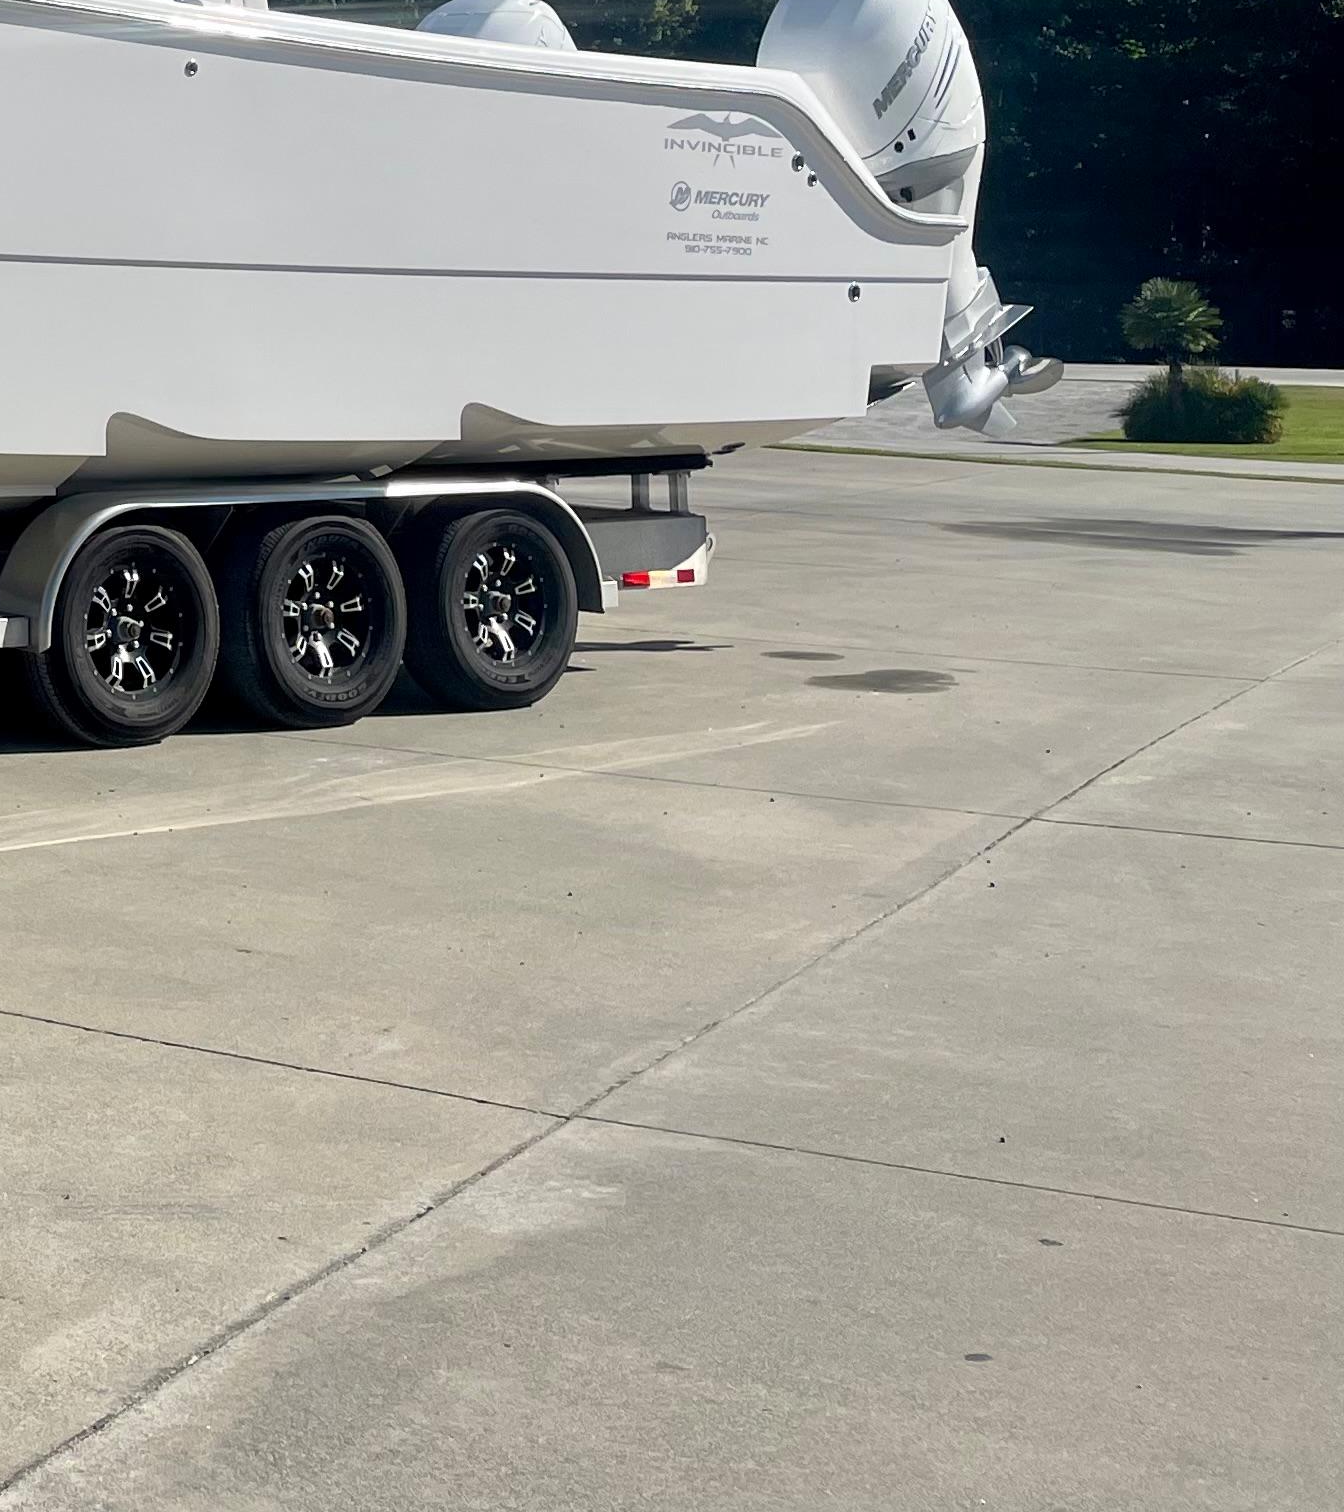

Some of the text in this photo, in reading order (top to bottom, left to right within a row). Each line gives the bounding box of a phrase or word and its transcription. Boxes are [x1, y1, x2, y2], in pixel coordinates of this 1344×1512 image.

[664, 138, 784, 158] INVINCIBLE
[694, 190, 771, 208] MERCURY
[666, 231, 769, 246] ANGLERS MARINE NC
